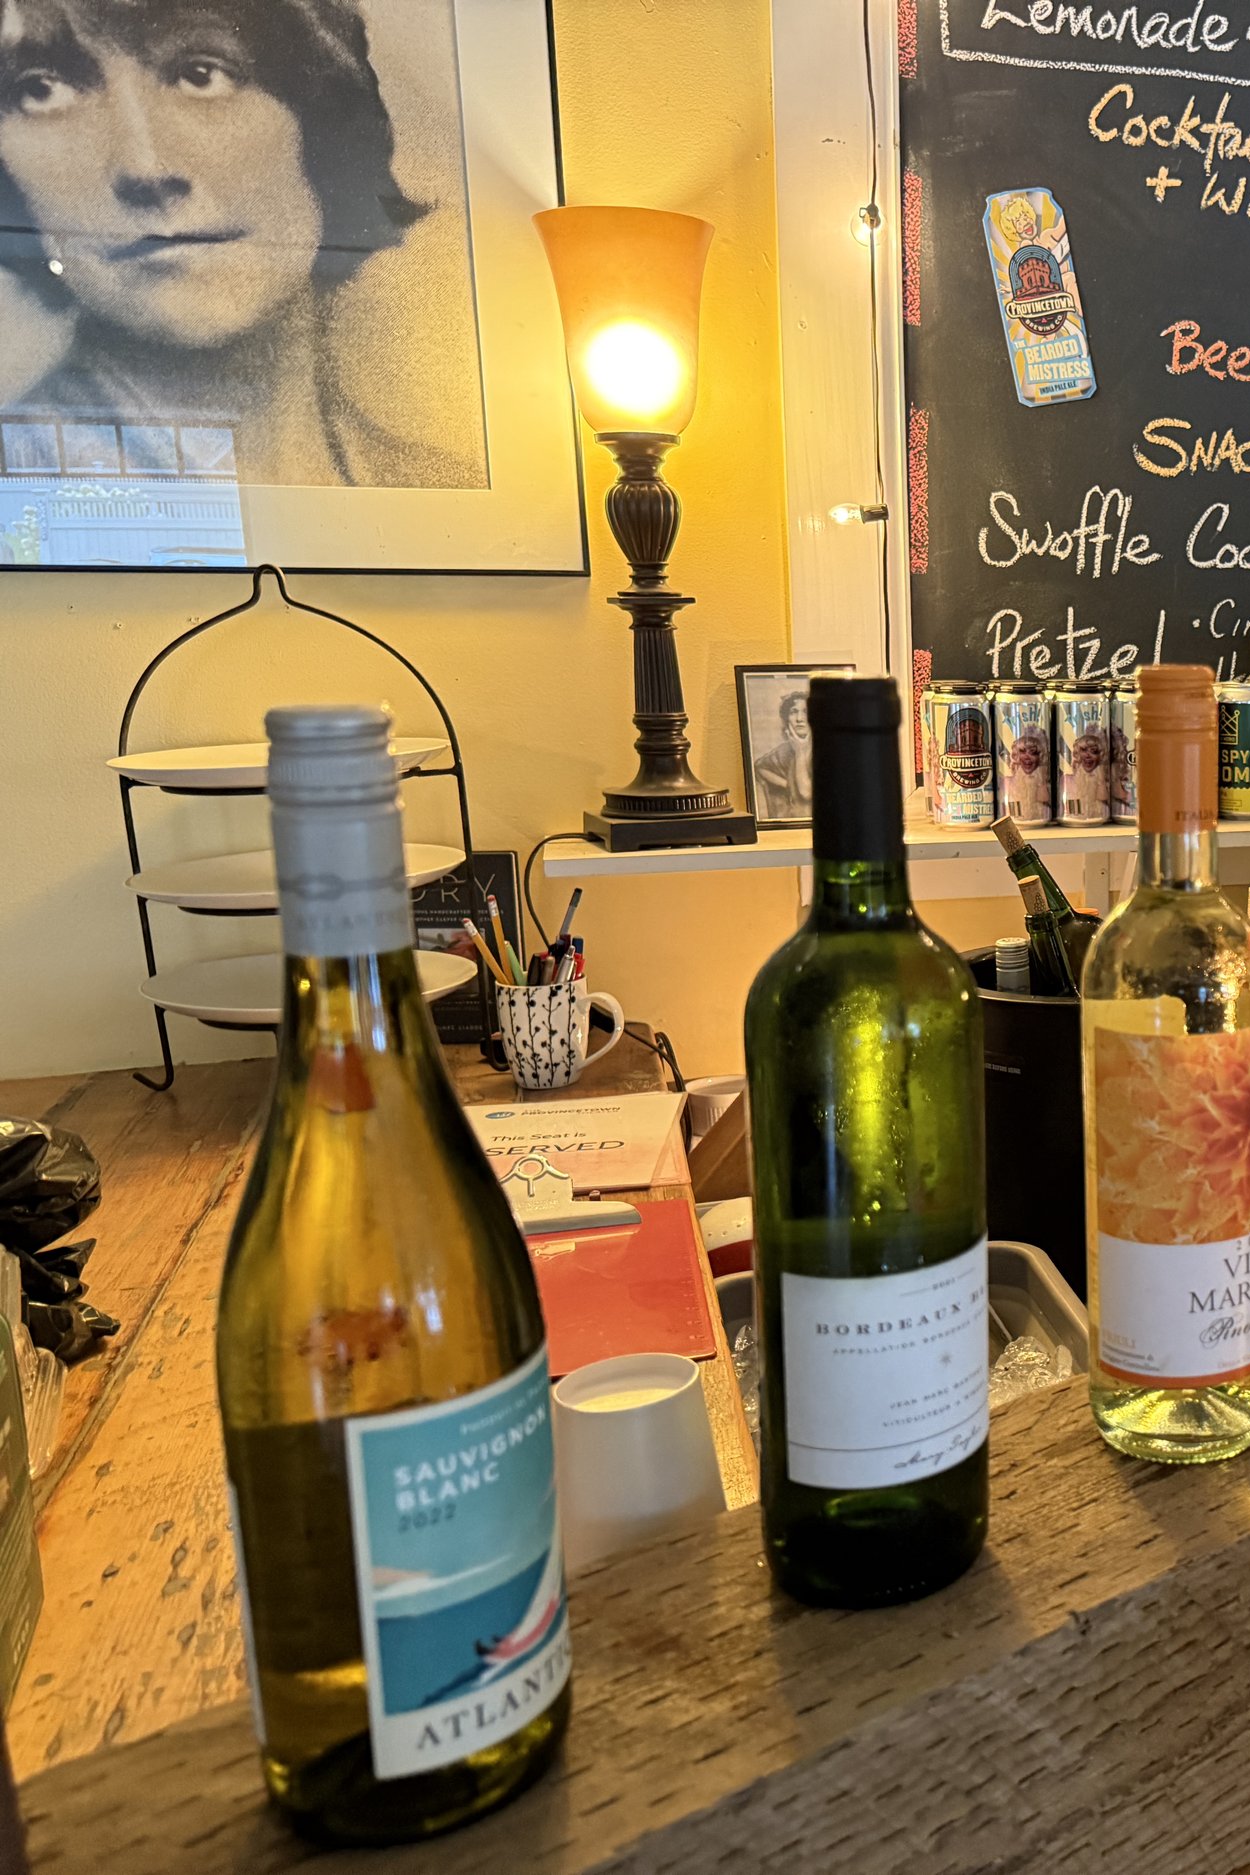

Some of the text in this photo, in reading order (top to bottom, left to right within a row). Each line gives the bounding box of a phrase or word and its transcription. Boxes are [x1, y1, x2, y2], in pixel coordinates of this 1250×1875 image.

[980, 0, 1239, 51] Lemonade
[1009, 298, 1075, 317] PROVINCETOWN
[1025, 318, 1057, 332] BREWING
[1025, 339, 1079, 365] BEARDED
[1027, 361, 1091, 381] MISTRESS
[1039, 380, 1078, 395] INDIA PALE ALE
[978, 484, 1165, 579] Swoffle
[986, 605, 1166, 681] Pretzel
[491, 1131, 587, 1143] This Seat is
[815, 1300, 962, 1336] BORDEAUX
[832, 1340, 916, 1356] APPELLATION
[393, 1404, 546, 1487] SAUVIGNON
[395, 1460, 501, 1512] BLANC
